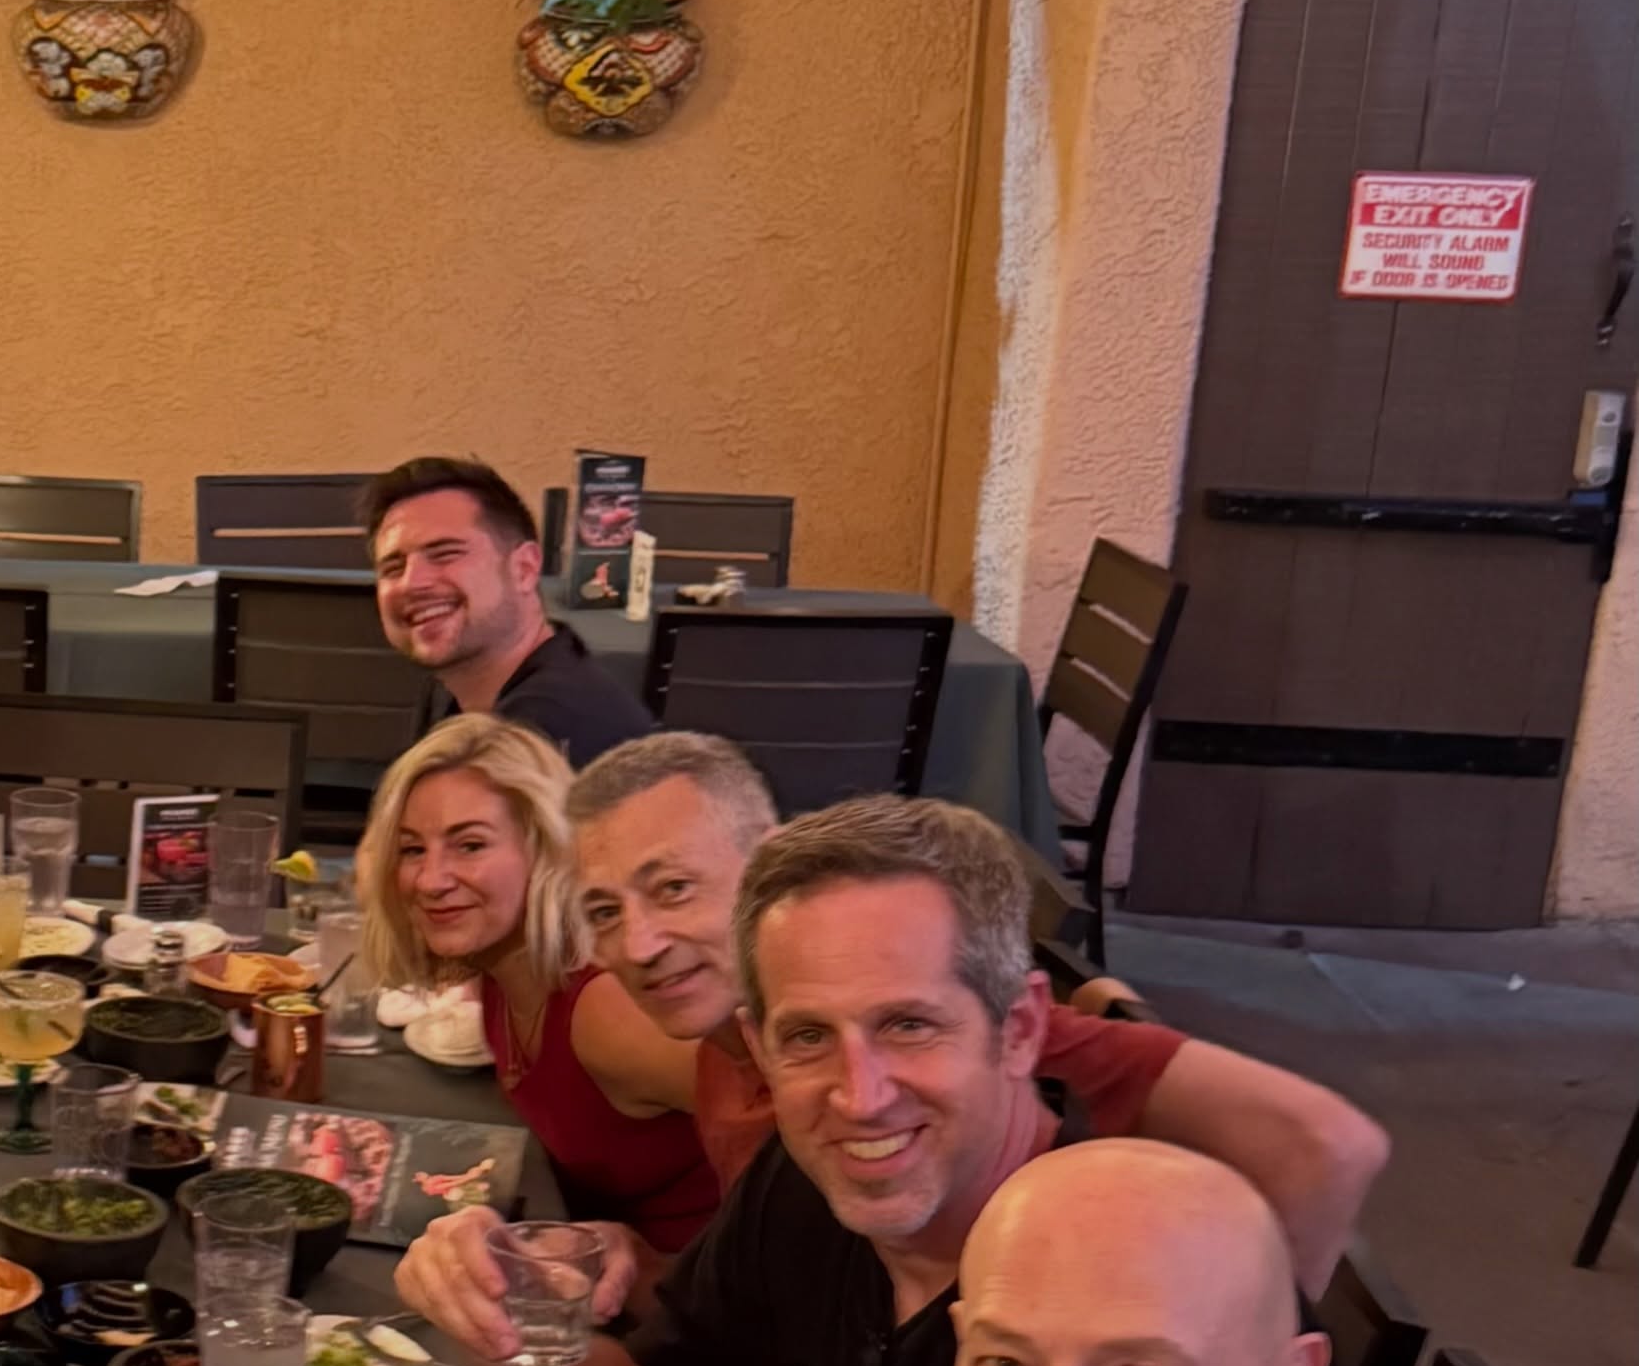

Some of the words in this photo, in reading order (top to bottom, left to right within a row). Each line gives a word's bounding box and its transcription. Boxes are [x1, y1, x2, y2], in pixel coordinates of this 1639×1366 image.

[1367, 185, 1521, 208] EMERGENCY
[1374, 206, 1433, 225] EXIT
[1438, 206, 1507, 227] ONLY
[1363, 232, 1443, 250] SECURITY
[1449, 235, 1510, 252] ALARM
[1383, 253, 1421, 269] WILL
[1429, 254, 1485, 271] SOUND
[1350, 270, 1366, 285] IF
[1372, 271, 1415, 286] DOOR
[1423, 273, 1438, 287] IS
[1445, 273, 1509, 290] OPENED
